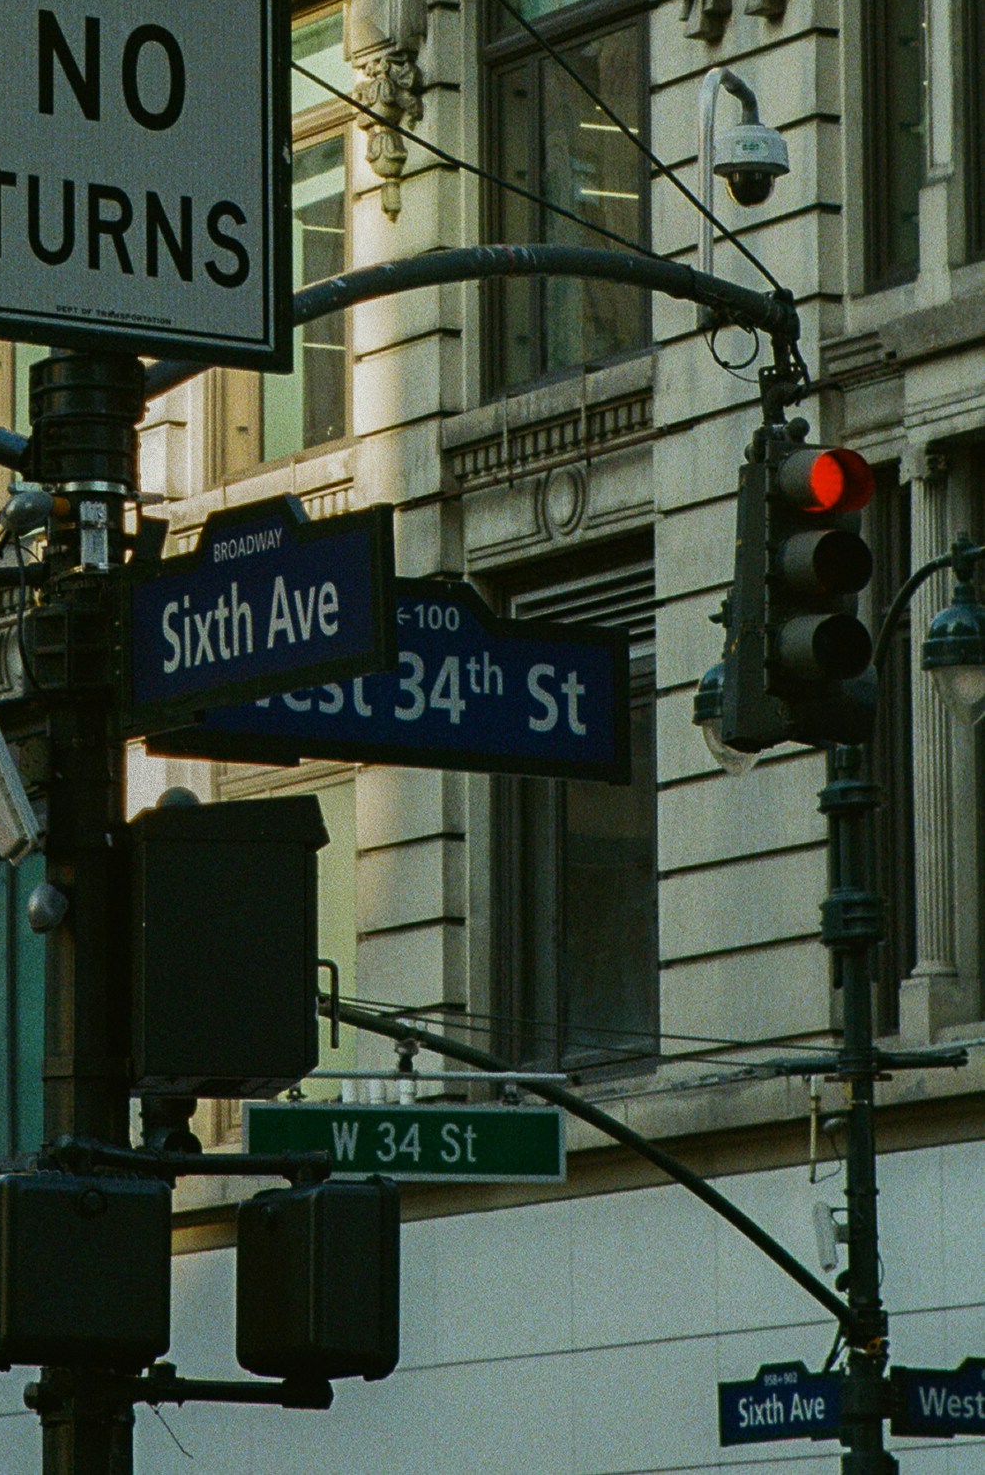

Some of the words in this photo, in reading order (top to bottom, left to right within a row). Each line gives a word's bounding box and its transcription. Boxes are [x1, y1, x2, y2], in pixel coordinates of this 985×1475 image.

[38, 9, 185, 131] NO
[214, 527, 282, 563] BROADWAY
[162, 582, 254, 674] Sixth
[267, 575, 339, 649] Ave
[414, 604, 460, 631] 100
[394, 651, 503, 724] 34th
[527, 663, 586, 735] St
[332, 1121, 359, 1161] W
[376, 1121, 422, 1162] 34
[441, 1122, 477, 1163] St
[738, 1393, 784, 1428] Sixth
[790, 1392, 826, 1422] Ave
[918, 1386, 985, 1418] West
